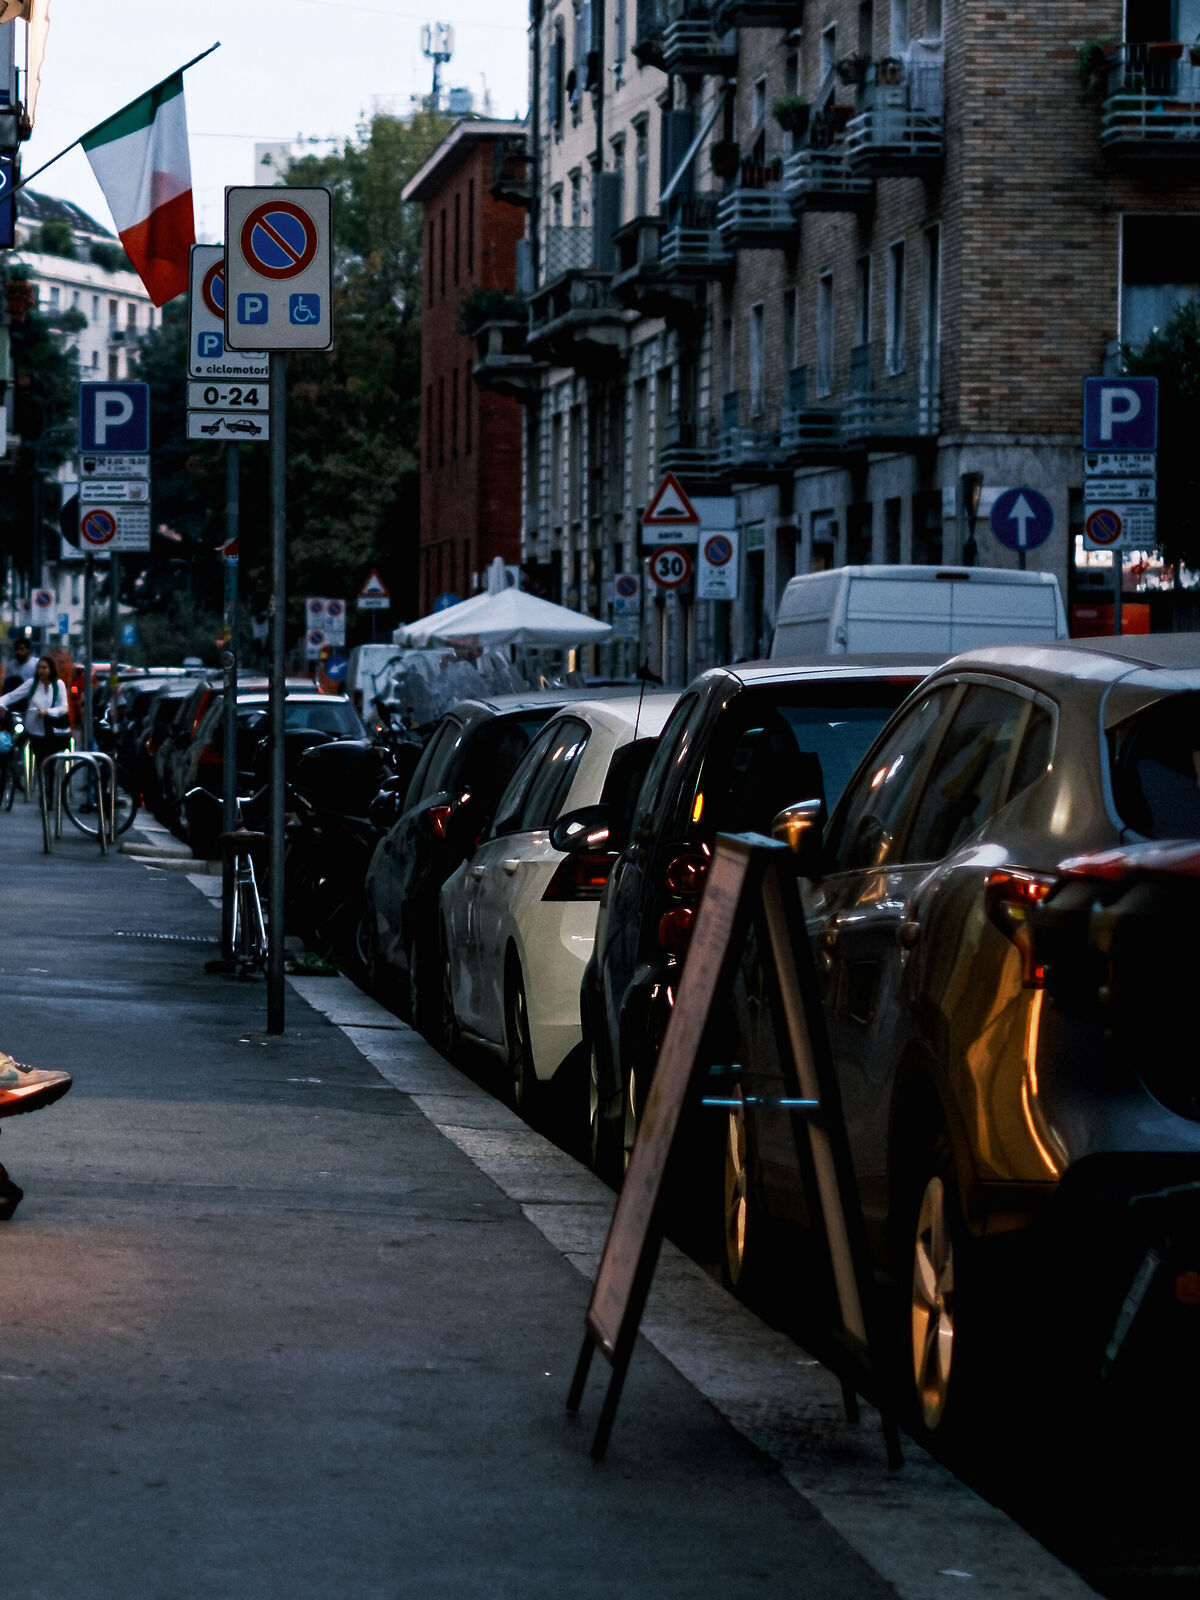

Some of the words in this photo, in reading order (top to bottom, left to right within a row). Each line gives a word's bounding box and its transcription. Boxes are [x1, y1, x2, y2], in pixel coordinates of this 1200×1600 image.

[244, 297, 263, 321] P
[203, 335, 219, 354] P
[206, 364, 269, 374] ciclomotori
[204, 387, 259, 405] 0-24
[94, 391, 134, 445] P
[1100, 388, 1141, 441] P
[659, 556, 683, 577] 30
